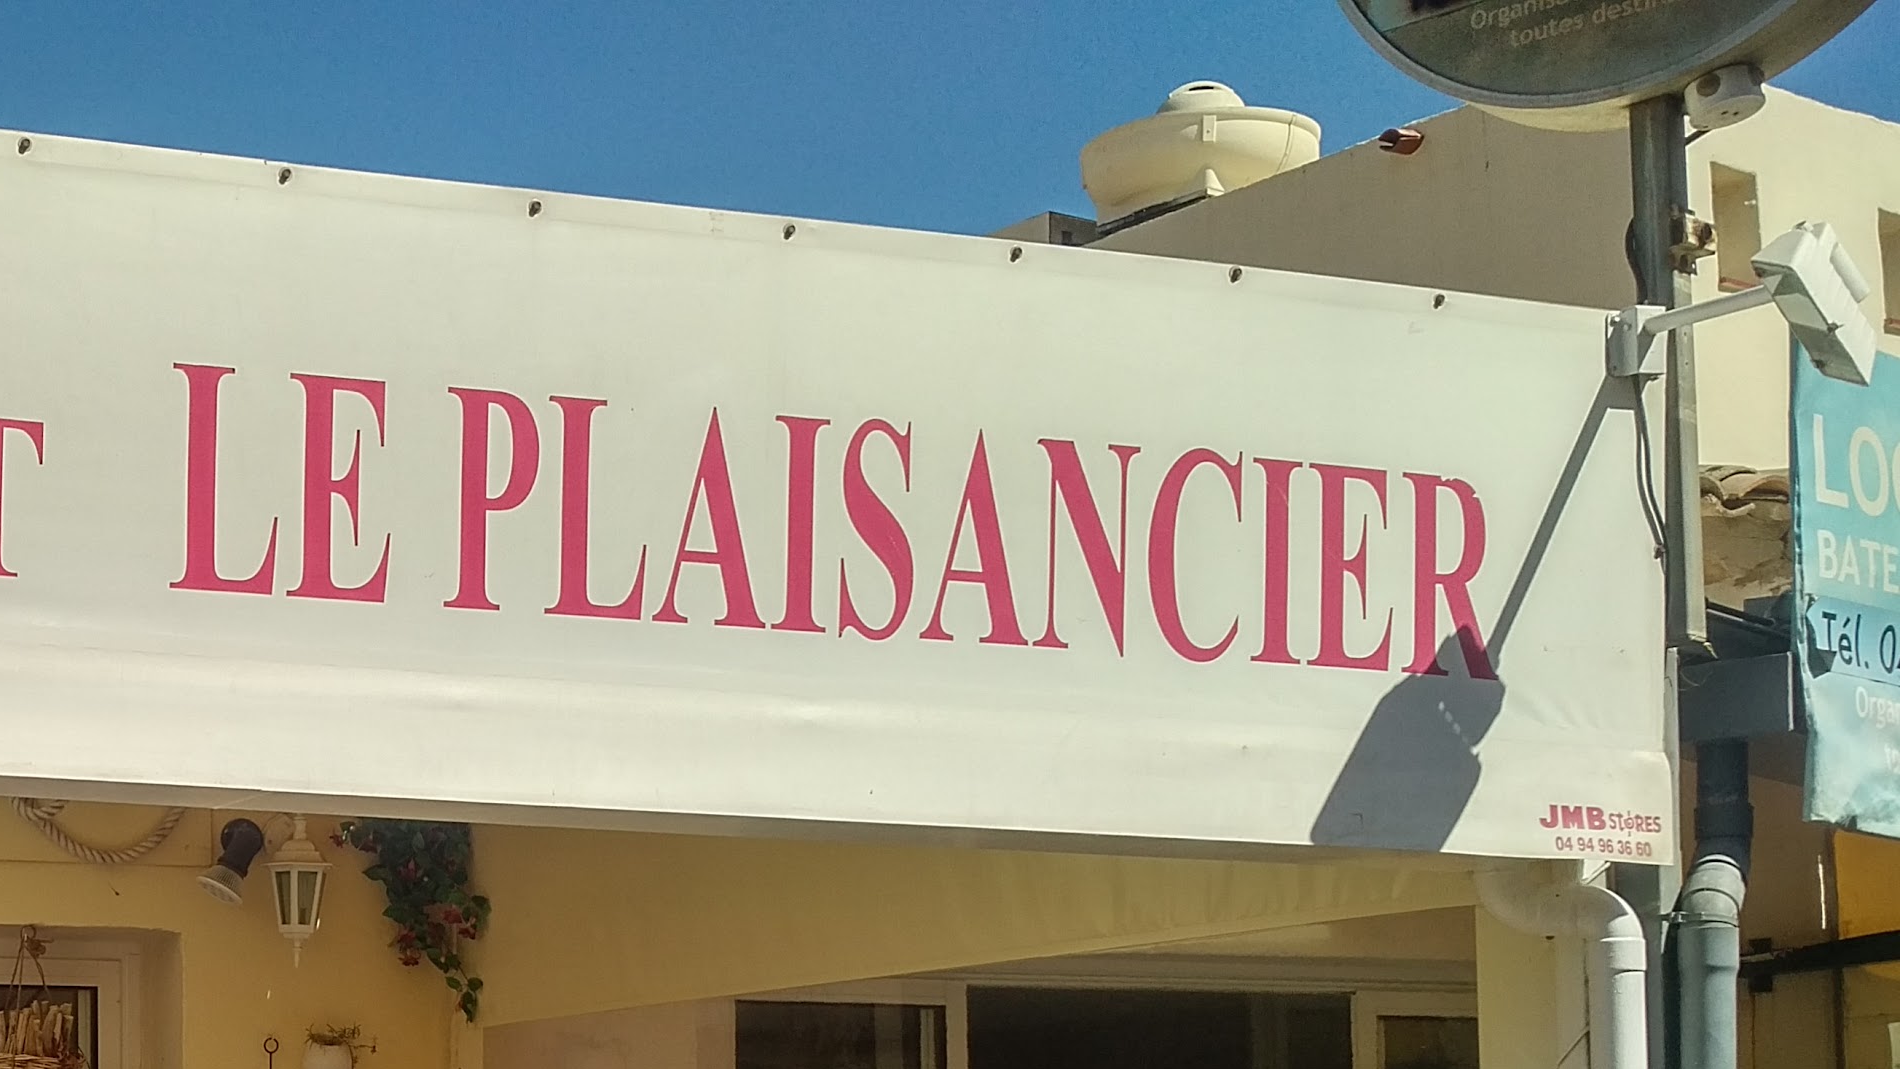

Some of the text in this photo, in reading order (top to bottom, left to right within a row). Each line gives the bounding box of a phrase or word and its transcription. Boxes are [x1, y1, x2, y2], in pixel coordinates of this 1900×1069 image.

[1813, 413, 1900, 517] LO
[169, 364, 391, 604] LE
[446, 388, 1500, 681] PLAISANCIER
[1539, 804, 1607, 831] JMB
[1555, 836, 1652, 857] 04 94 96 36 60
